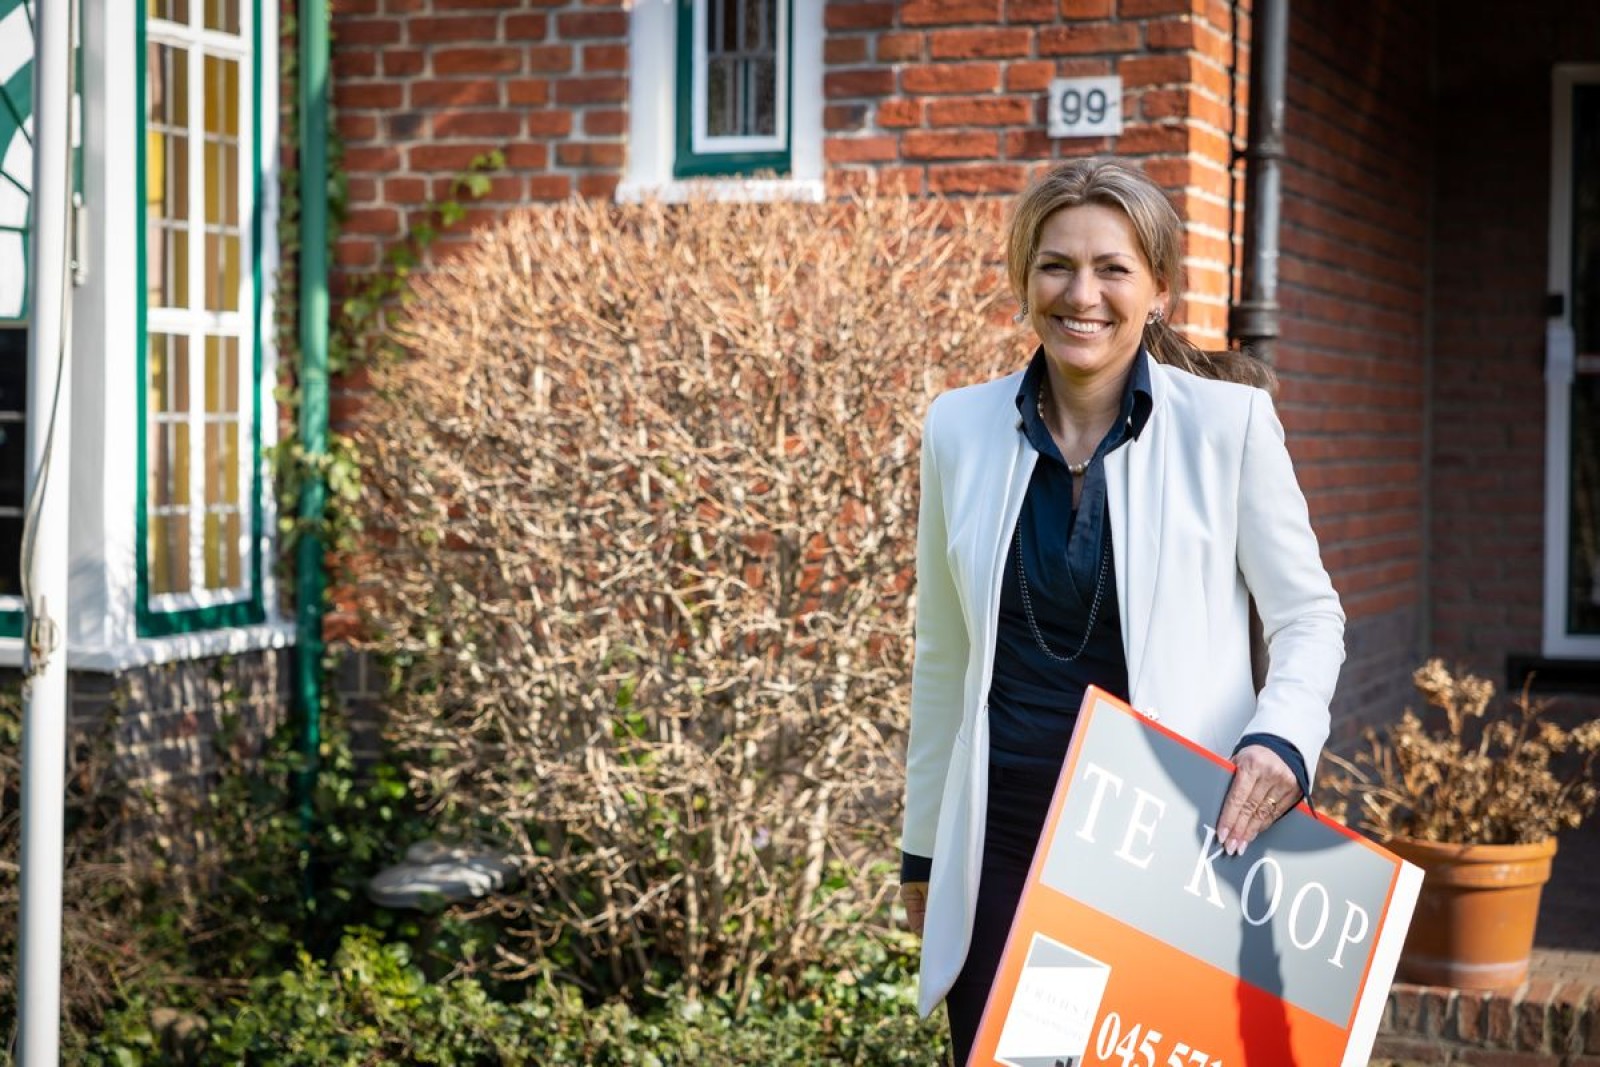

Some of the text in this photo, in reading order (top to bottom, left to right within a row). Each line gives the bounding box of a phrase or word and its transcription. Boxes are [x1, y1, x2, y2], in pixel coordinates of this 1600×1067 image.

[1061, 88, 1106, 125] 99
[1075, 762, 1369, 969] TE KOOP
